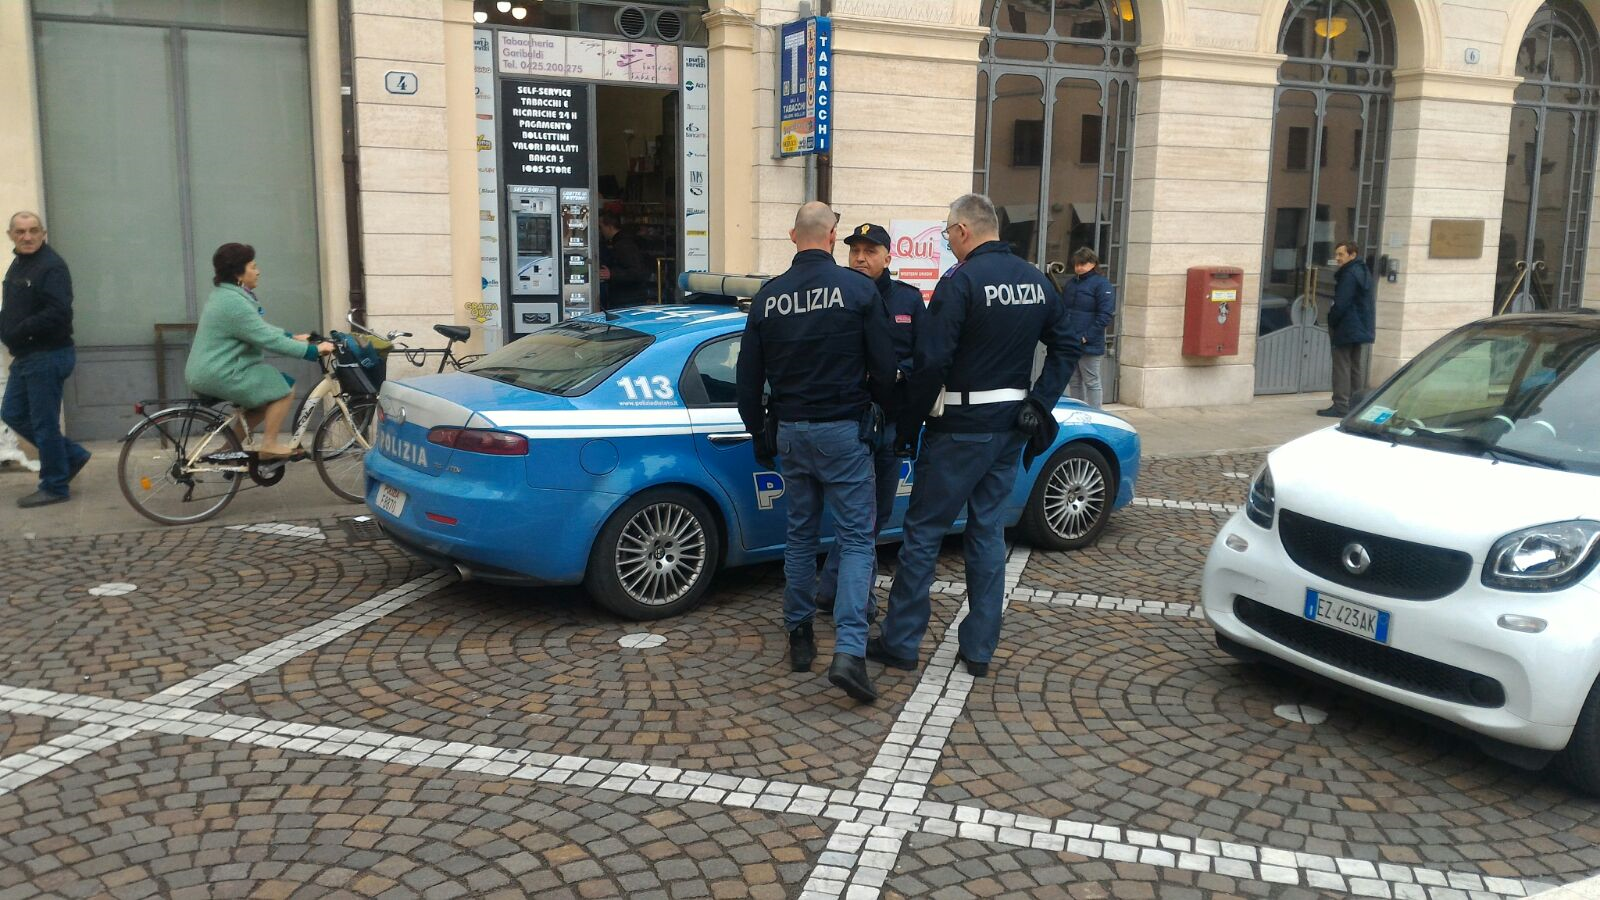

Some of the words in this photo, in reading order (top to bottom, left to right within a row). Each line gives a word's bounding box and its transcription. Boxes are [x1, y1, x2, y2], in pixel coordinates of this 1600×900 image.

[502, 35, 555, 49] Tabaccheria
[502, 48, 545, 60] Garibaldi
[502, 59, 518, 69] Tel.
[520, 60, 584, 74] 0425.200.275
[396, 75, 408, 91] 4
[517, 86, 572, 98] SELF-SERVICE
[818, 36, 829, 149] TABACCHI
[520, 97, 562, 108] TABACCHI
[563, 100, 569, 109] E
[783, 102, 806, 113] TABACCHI
[512, 108, 557, 119] RICARICHE
[558, 111, 570, 120] 24
[571, 111, 578, 120] H
[519, 119, 572, 131] PAGAMENTO
[521, 131, 570, 142] BOLLETTINI
[512, 141, 543, 152] VALORI
[545, 143, 579, 153] BOLLATI
[528, 153, 557, 163] BANCA
[545, 165, 572, 174] STORE
[896, 236, 934, 259] Qui
[984, 283, 1046, 307] POLIZIA
[464, 302, 499, 311] GRATTA
[764, 287, 845, 318] POLIZIA
[616, 375, 675, 400] 113
[379, 430, 428, 468] POLIZIA
[1317, 598, 1334, 619] EZ
[1336, 605, 1377, 633] 423AK
